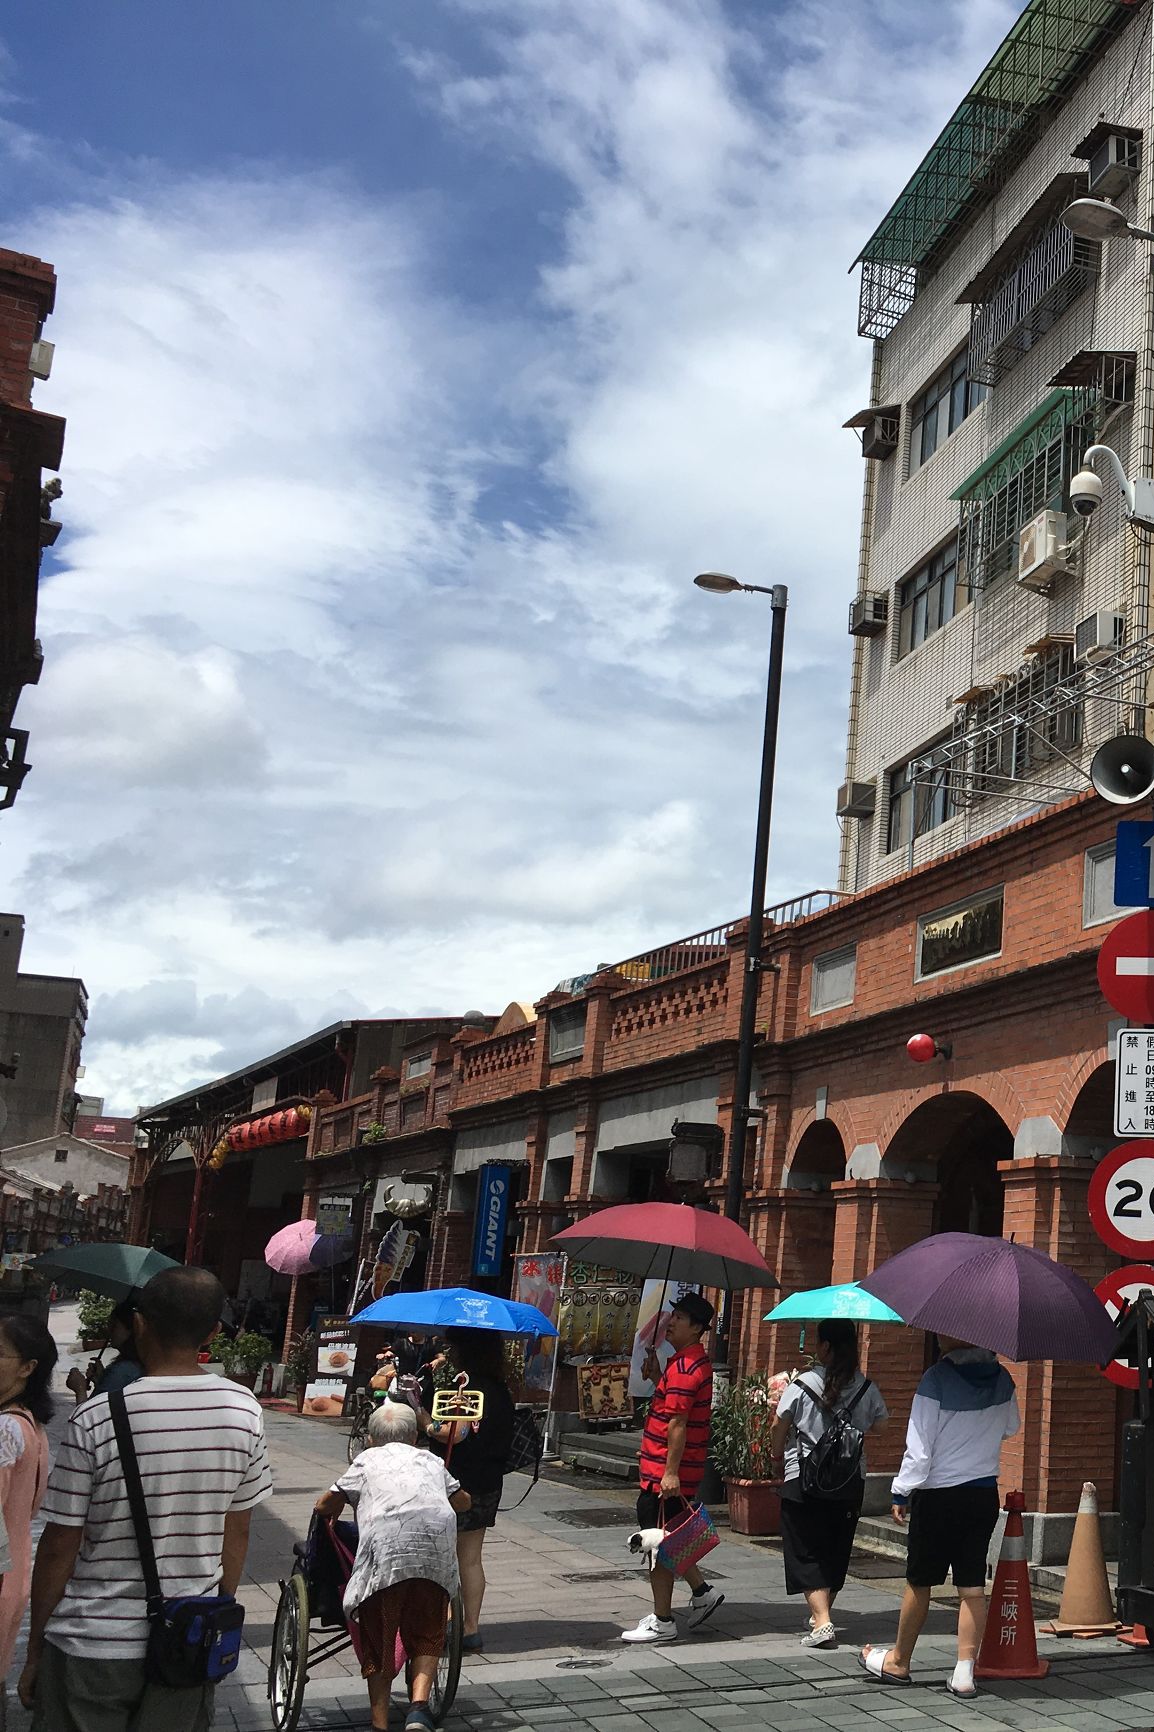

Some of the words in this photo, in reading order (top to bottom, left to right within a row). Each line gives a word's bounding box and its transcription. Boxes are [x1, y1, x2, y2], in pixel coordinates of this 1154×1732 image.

[1123, 1035, 1139, 1131] 禁止進入
[485, 1195, 501, 1261] GIANT
[999, 1579, 1019, 1647] 三峽所
